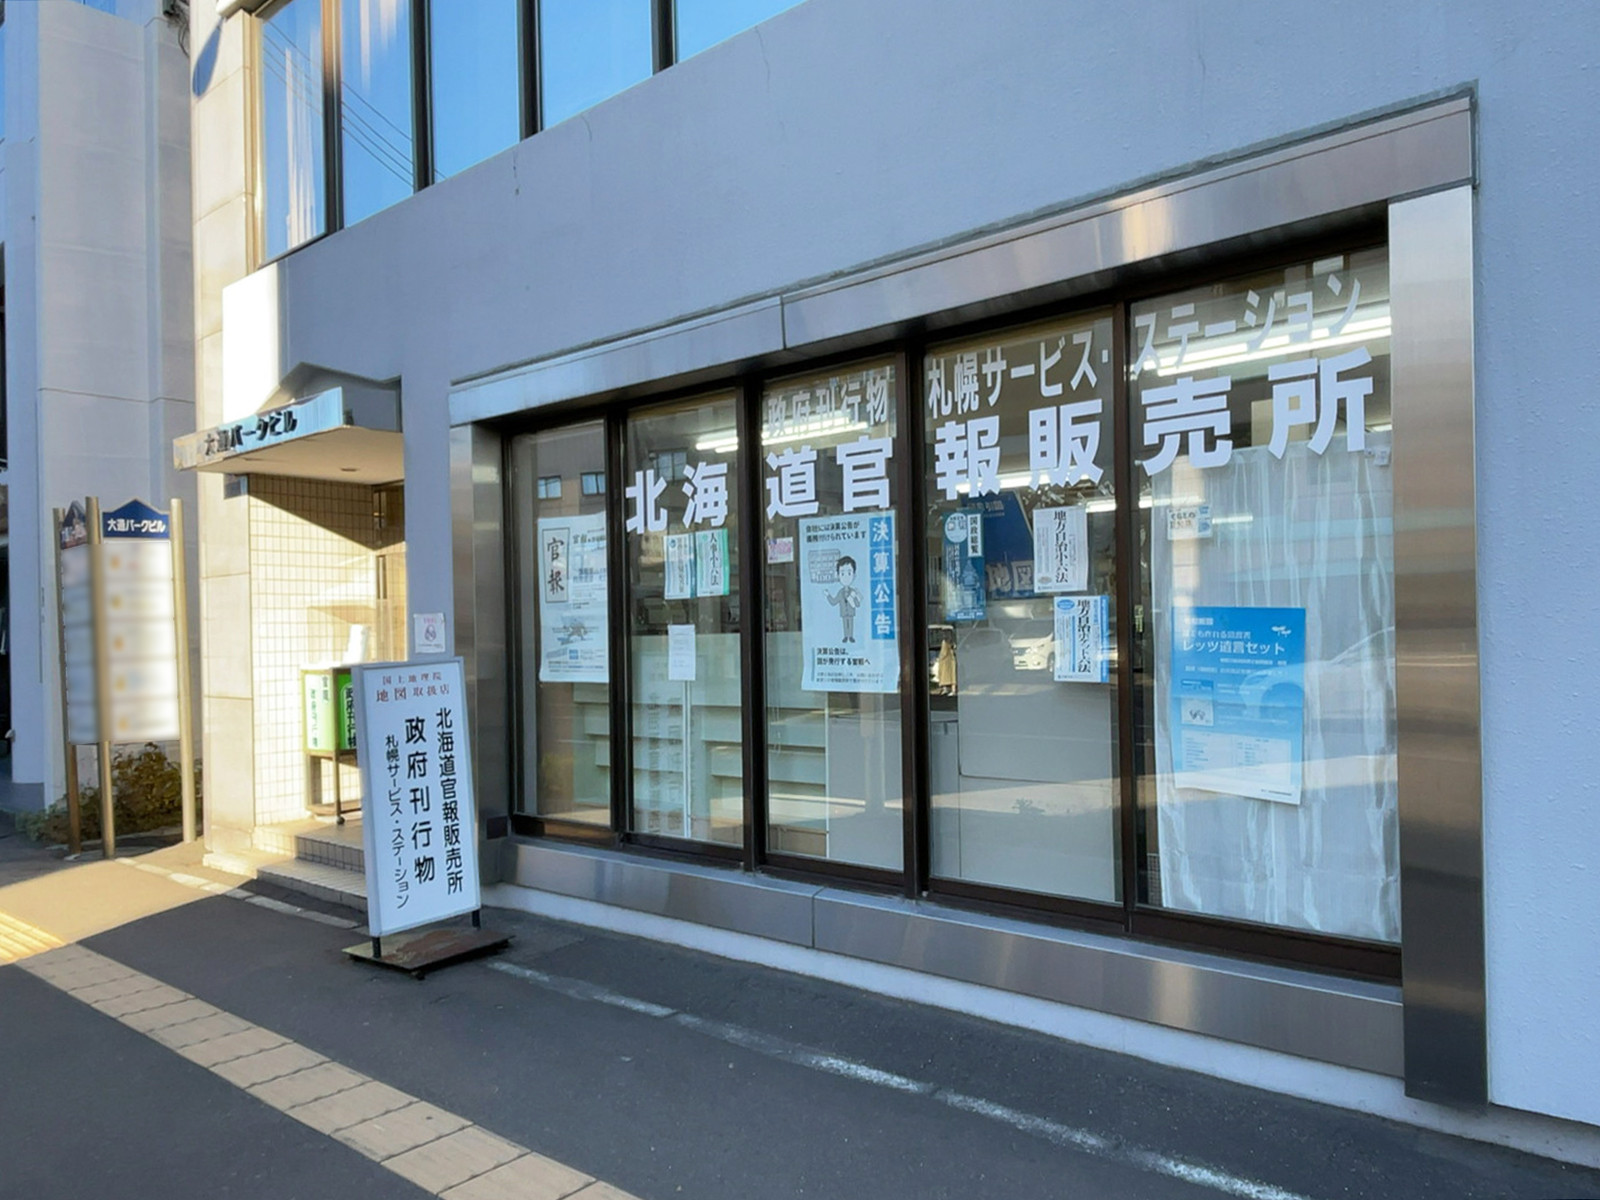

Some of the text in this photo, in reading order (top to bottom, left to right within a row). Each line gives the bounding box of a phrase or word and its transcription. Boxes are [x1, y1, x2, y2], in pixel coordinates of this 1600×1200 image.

[625, 346, 1374, 535] 北海道官報販売所
[106, 517, 167, 534] 大通パークビル
[1053, 509, 1069, 584] 地方自治小六法
[546, 536, 565, 596] 官報
[872, 520, 893, 635] 決算公告
[382, 671, 442, 686] 国土地理院
[1182, 640, 1286, 656] レッツ遺言セット
[376, 684, 450, 703] 地図取扱店
[384, 733, 410, 910] 札幌サービス・ステーション
[404, 716, 436, 885] 政府刊行物
[435, 706, 464, 896] 北海道官報販売所
